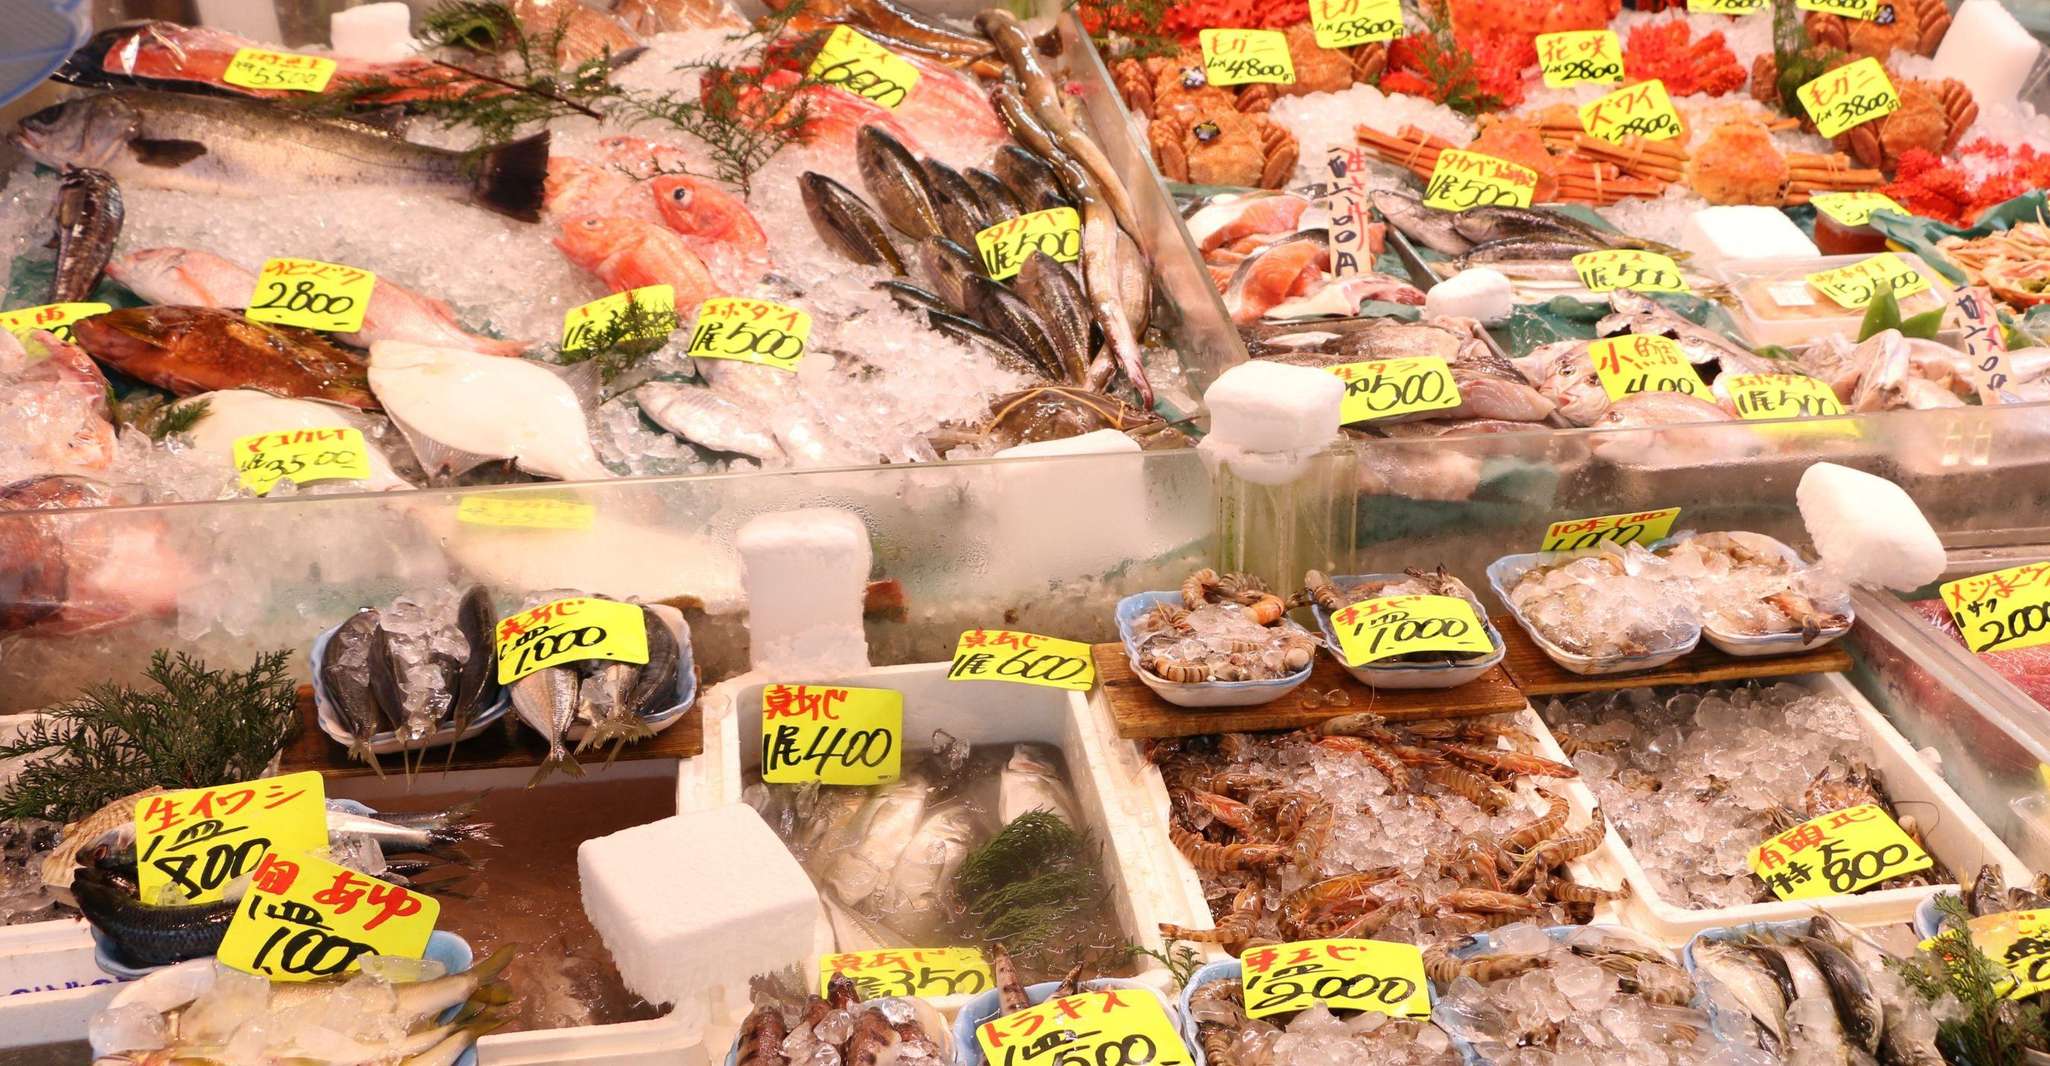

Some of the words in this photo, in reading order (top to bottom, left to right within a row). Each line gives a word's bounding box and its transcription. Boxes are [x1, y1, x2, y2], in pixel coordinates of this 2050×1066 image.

[1586, 86, 1654, 132] ズワイ
[144, 785, 306, 834] 生イワシ
